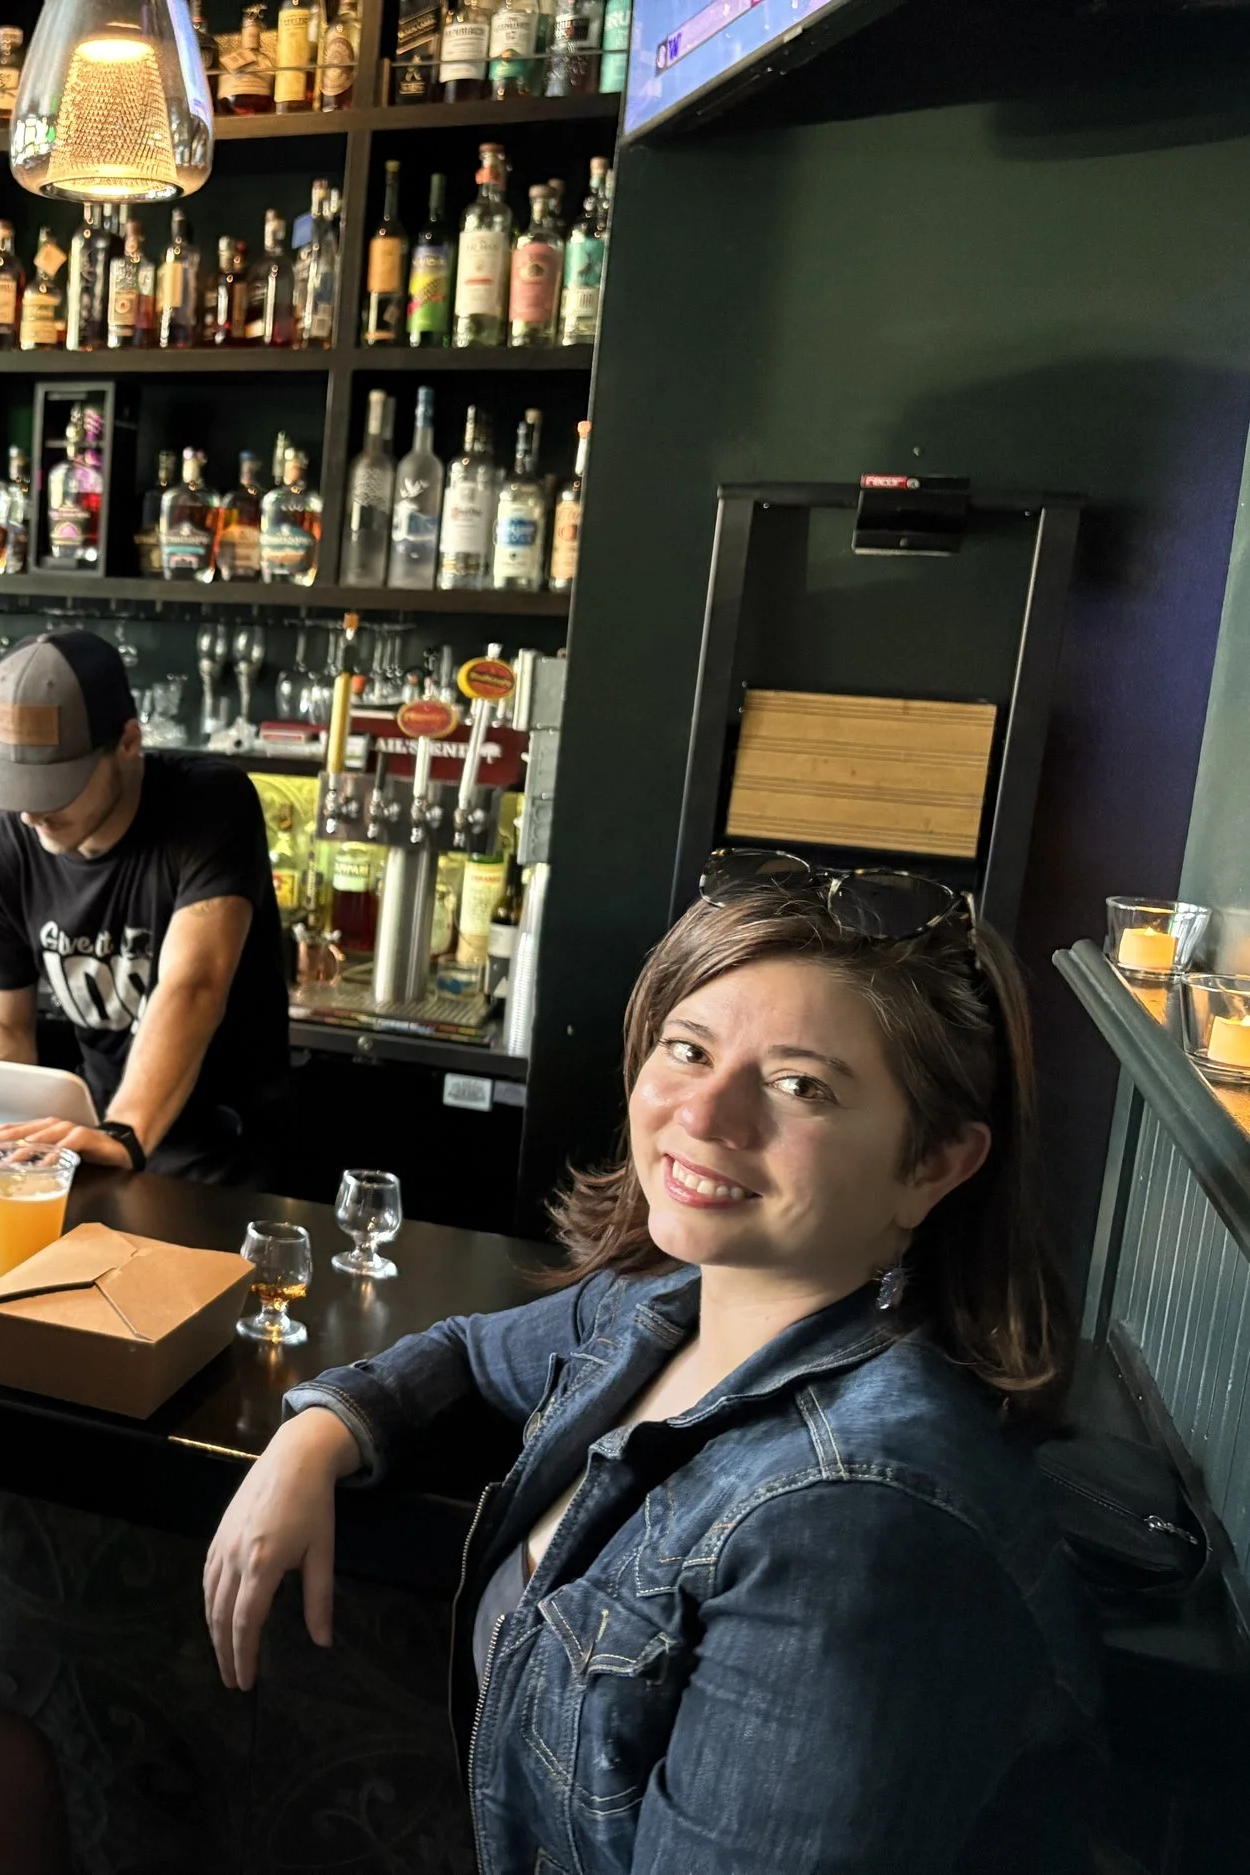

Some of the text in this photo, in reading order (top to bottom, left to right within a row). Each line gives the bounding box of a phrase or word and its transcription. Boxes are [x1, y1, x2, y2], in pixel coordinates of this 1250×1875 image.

[375, 736, 419, 756] AIL'S
[333, 860, 370, 878] AMPARI
[40, 920, 114, 957] Give it
